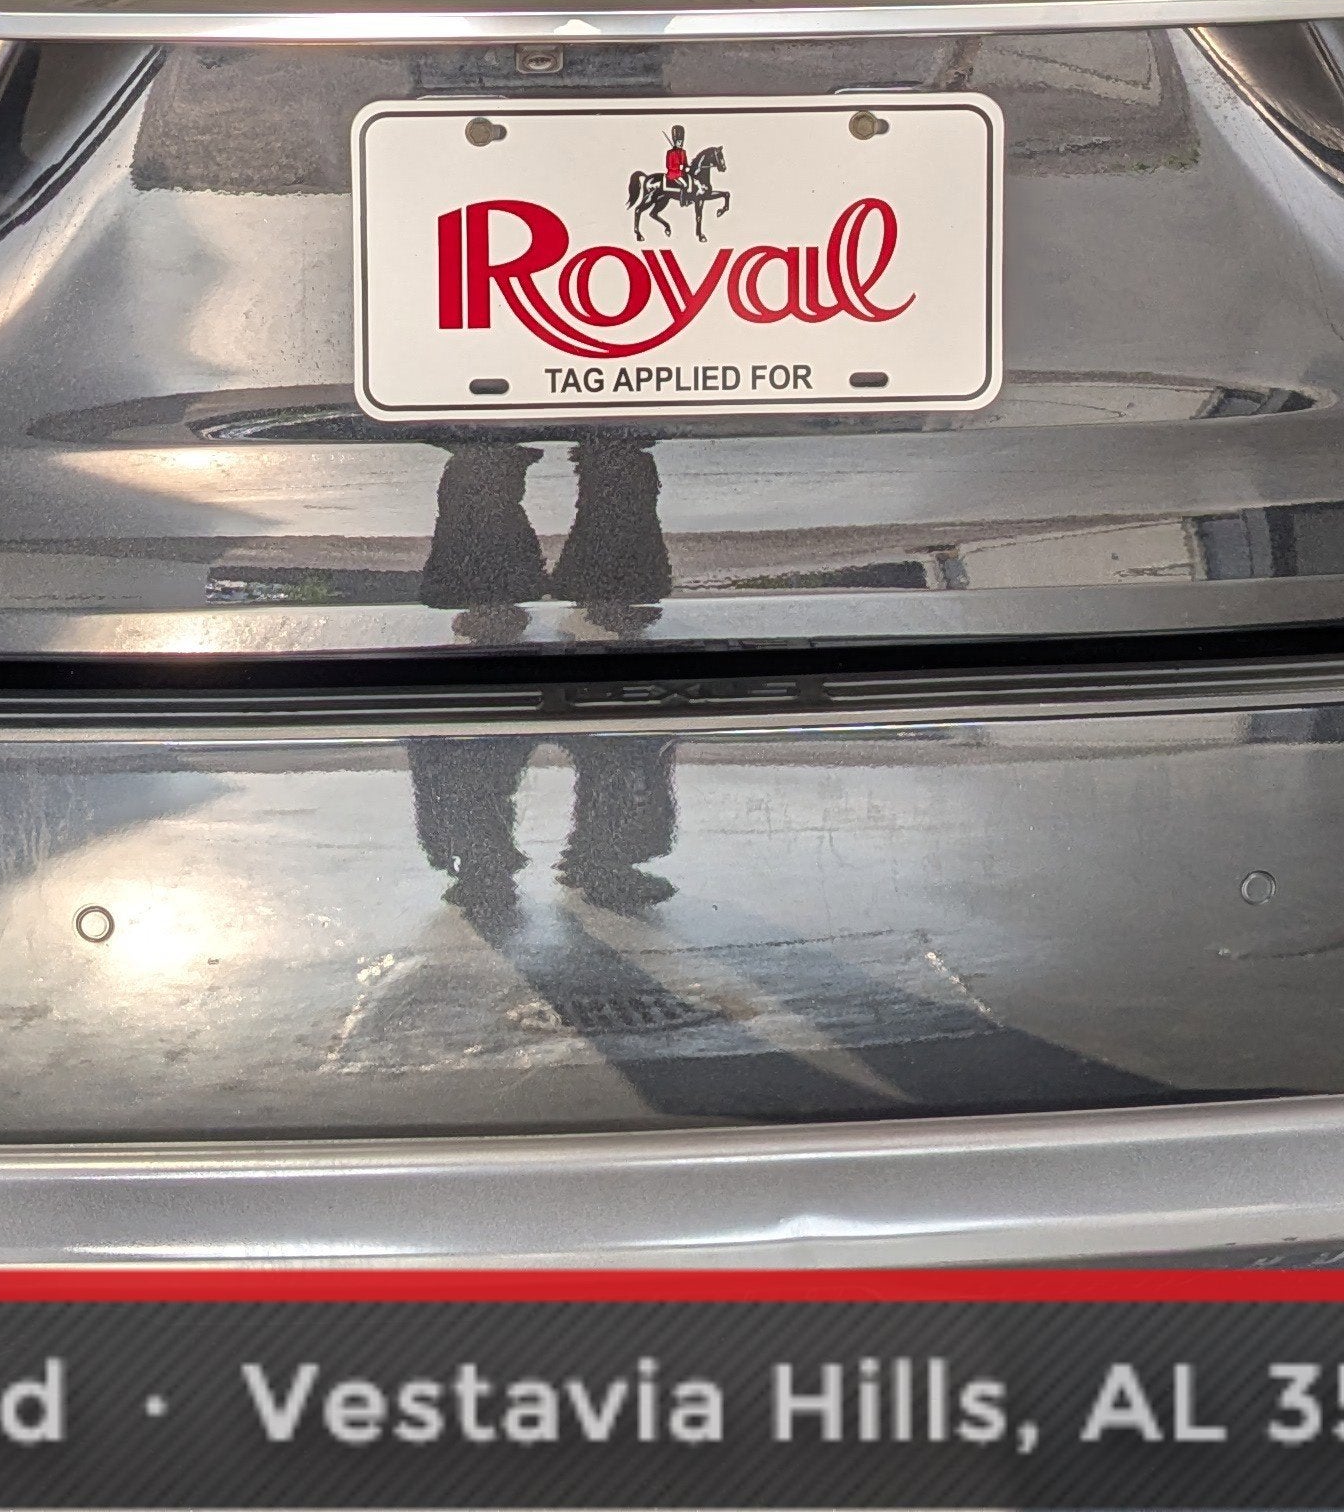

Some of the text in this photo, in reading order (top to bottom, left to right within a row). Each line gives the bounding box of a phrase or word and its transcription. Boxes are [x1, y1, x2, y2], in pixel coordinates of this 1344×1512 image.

[438, 197, 916, 359] Royal
[544, 363, 814, 394] TAG APPLIED FOR
